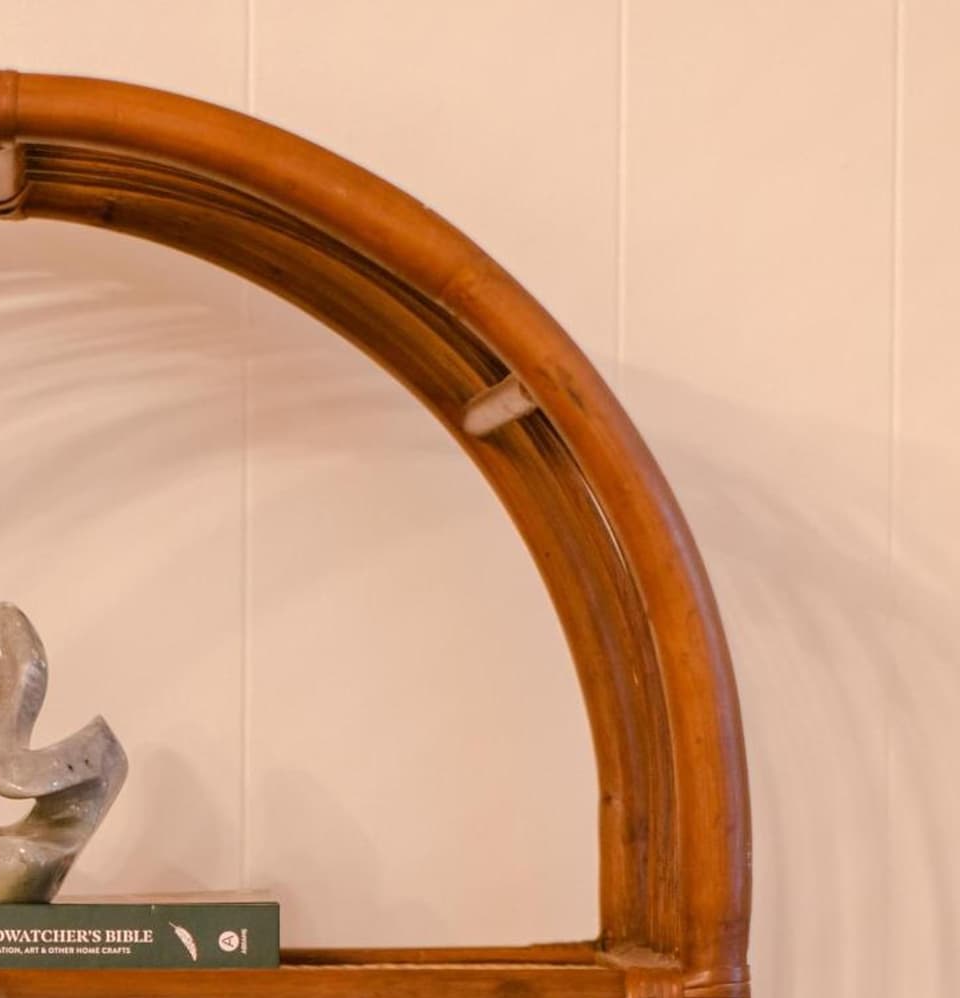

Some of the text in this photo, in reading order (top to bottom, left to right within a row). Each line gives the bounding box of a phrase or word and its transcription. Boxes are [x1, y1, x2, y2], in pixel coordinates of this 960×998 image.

[106, 930, 154, 943] BIBLE
[220, 933, 237, 950] A
[24, 946, 39, 954] ART
[41, 946, 47, 954] &
[48, 946, 75, 954] OTHER
[76, 946, 101, 954] HOME
[102, 946, 131, 954] CRAFTS
